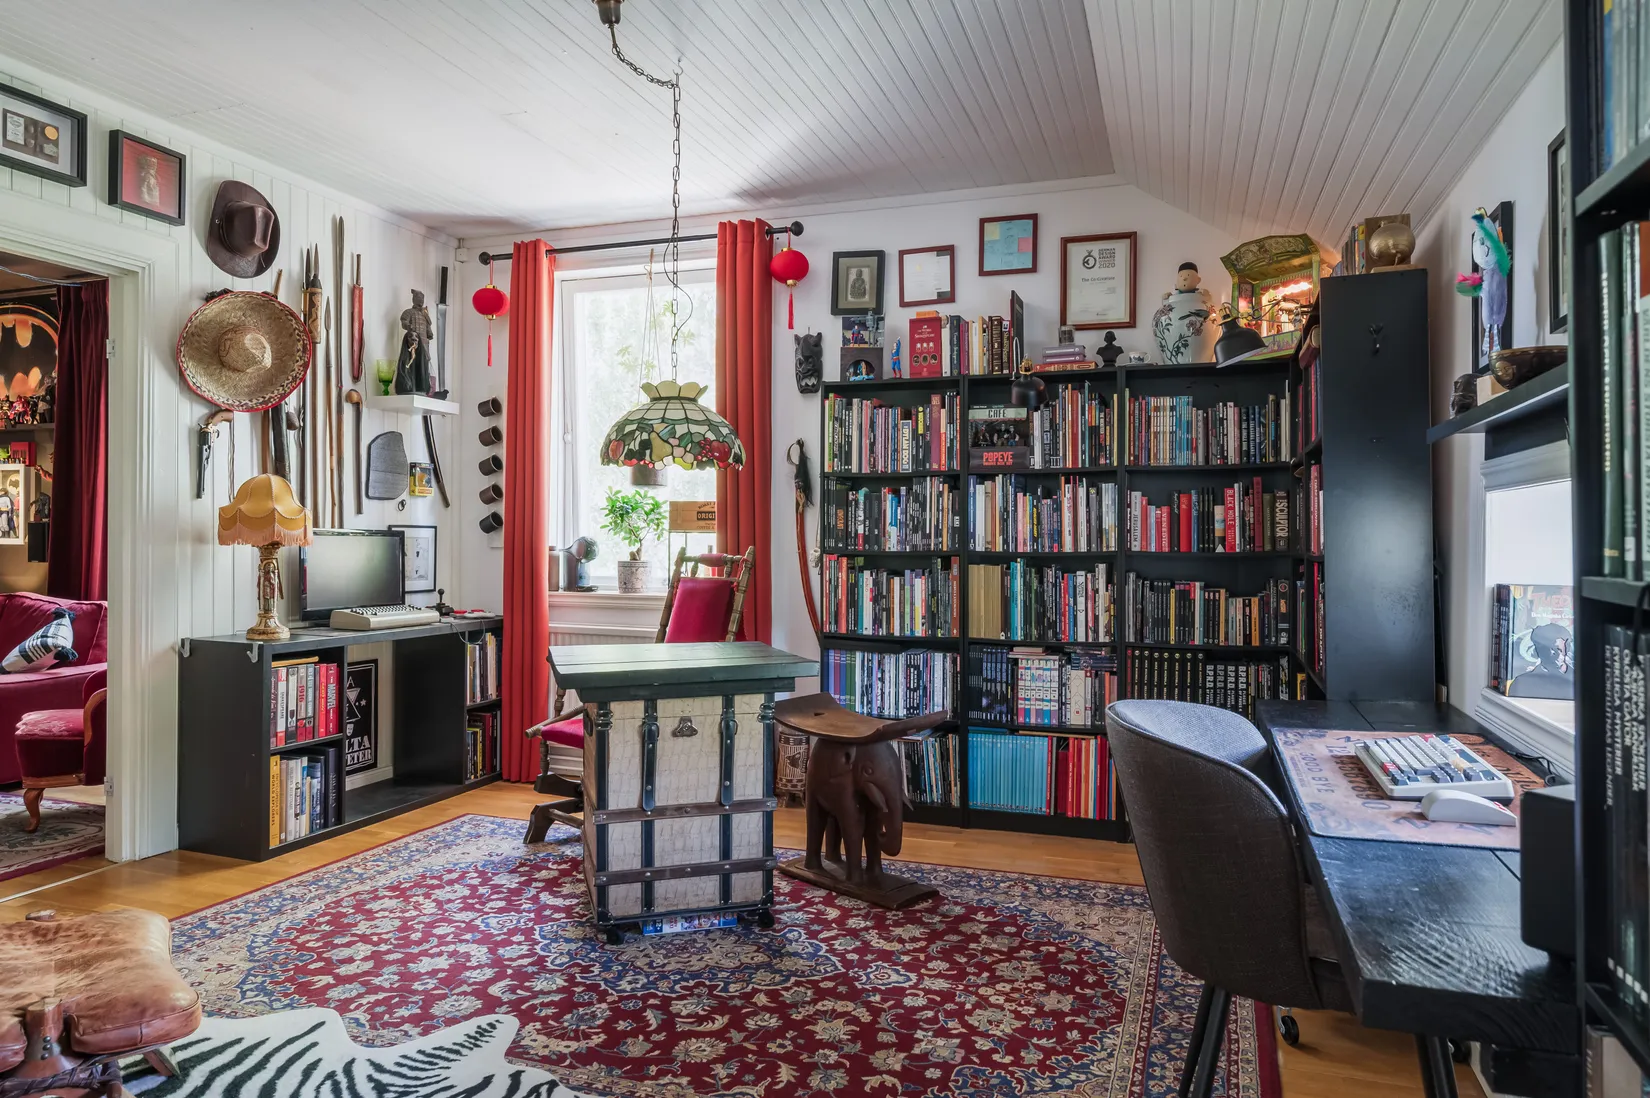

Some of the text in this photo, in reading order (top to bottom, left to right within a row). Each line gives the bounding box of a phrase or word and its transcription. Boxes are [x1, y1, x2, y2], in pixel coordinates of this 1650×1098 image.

[988, 410, 1007, 418] CAFE
[983, 452, 1014, 462] POPEYE
[1226, 489, 1234, 525] BLACK HOLE
[1275, 502, 1288, 537] SCULPTOR
[327, 683, 336, 709] MARVEL
[1613, 646, 1622, 775] KYRKLIGA MYSTERIER
[346, 749, 372, 765] ETER
